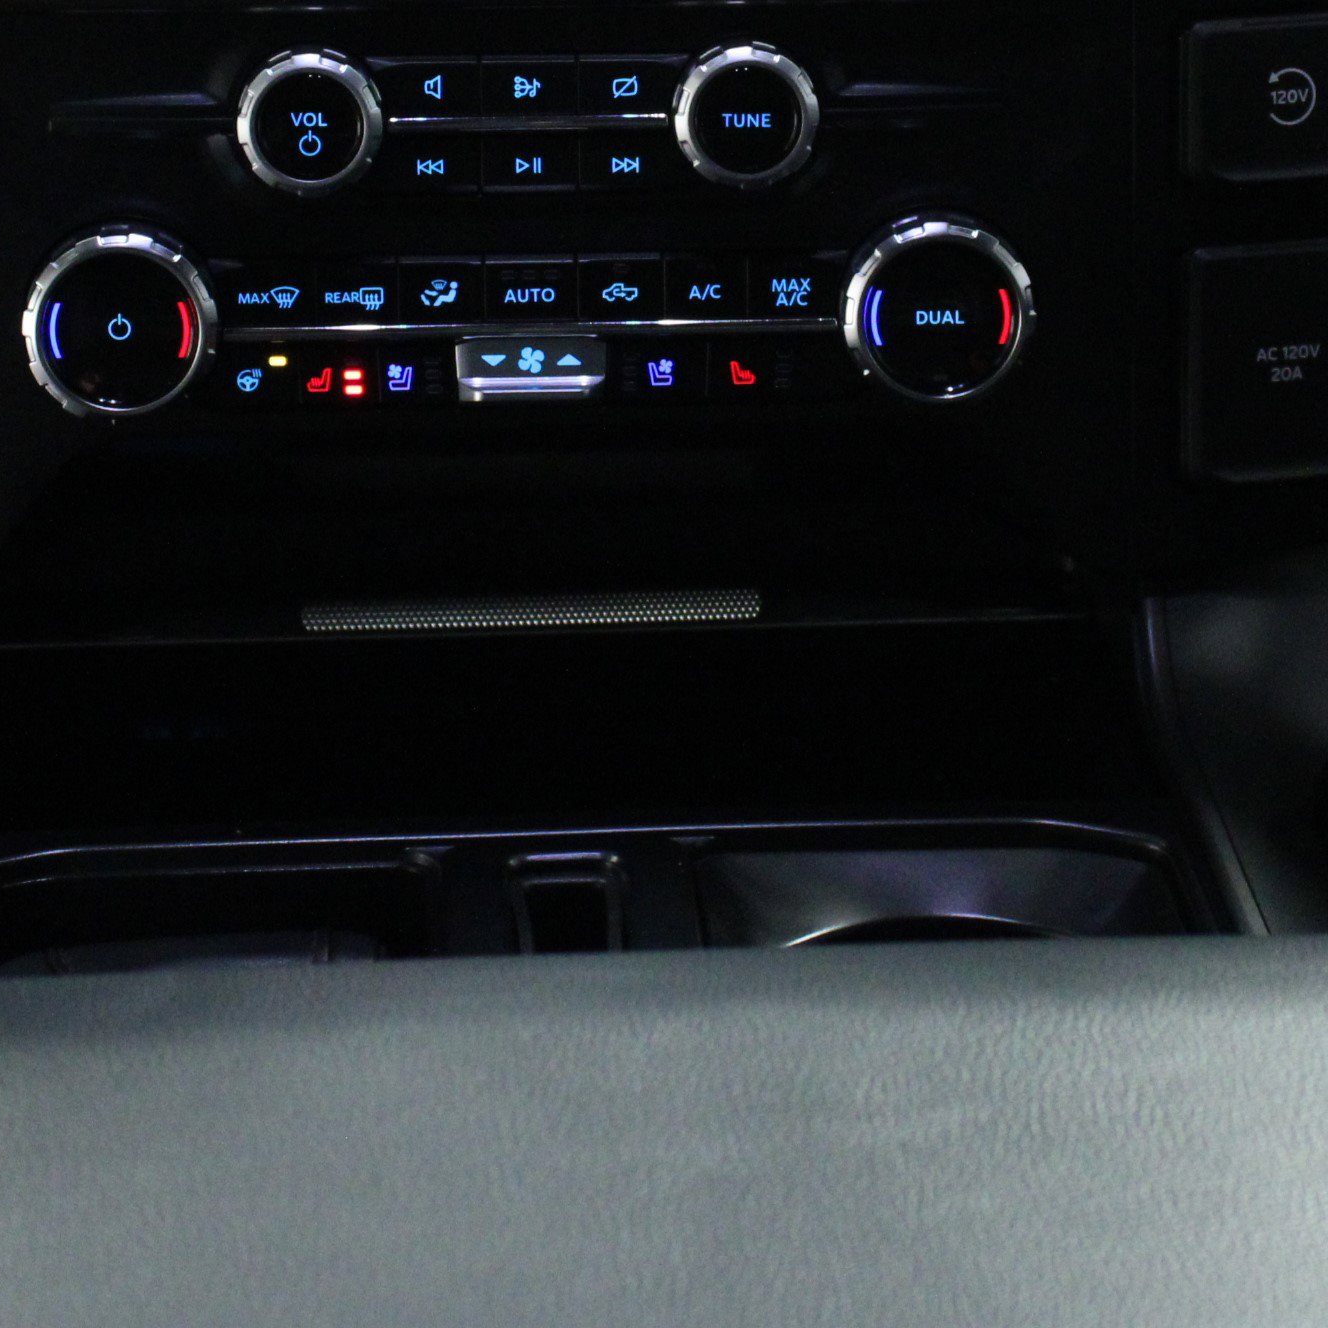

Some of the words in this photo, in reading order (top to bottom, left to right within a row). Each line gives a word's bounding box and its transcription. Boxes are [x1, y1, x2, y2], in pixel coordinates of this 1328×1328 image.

[1271, 88, 1309, 105] 120V
[290, 112, 328, 127] VOL
[721, 113, 772, 128] TUNE
[772, 279, 811, 293] MAX
[238, 292, 270, 304] MAX
[324, 291, 360, 304] REAR
[504, 287, 555, 304] AUTO
[688, 284, 722, 300] A/C
[776, 292, 809, 307] A/C
[915, 310, 965, 325] DUAL
[1256, 347, 1278, 362] AC
[1282, 344, 1321, 360] 120V
[1271, 366, 1303, 382] 20A
